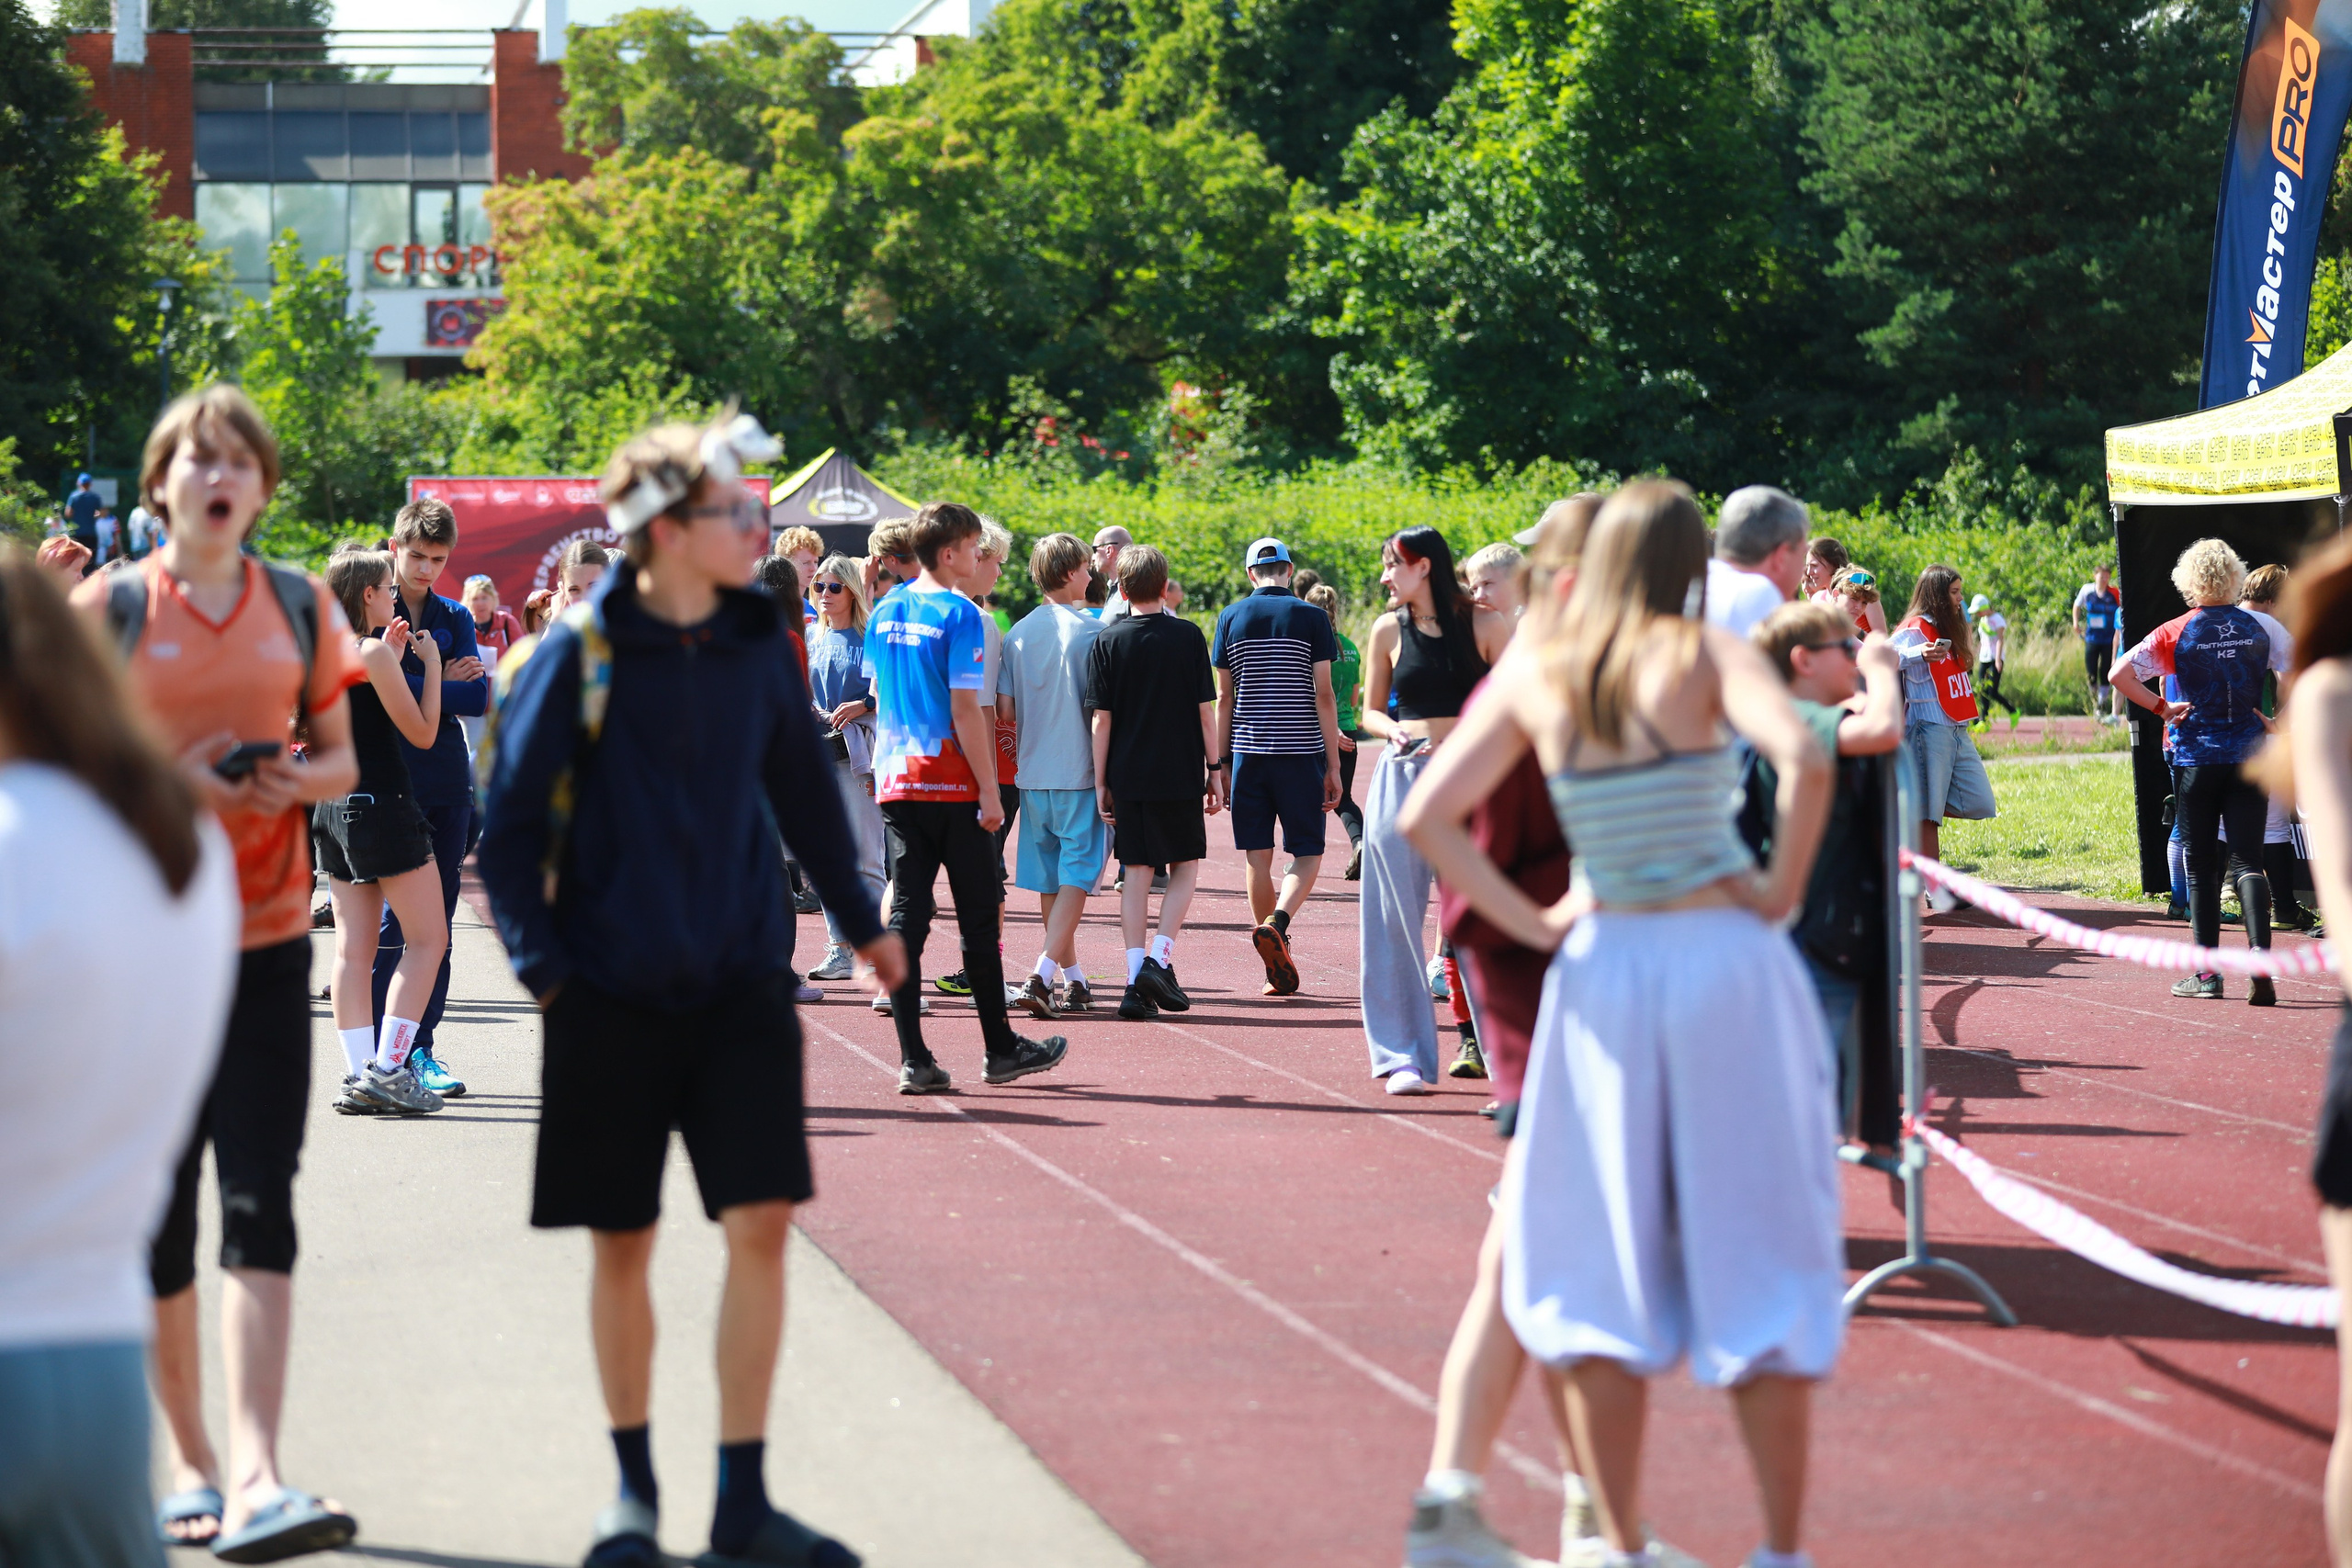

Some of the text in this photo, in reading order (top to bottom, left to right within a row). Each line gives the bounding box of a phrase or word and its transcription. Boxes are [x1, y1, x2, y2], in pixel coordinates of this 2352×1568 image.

[2278, 37, 2312, 164] PRO
[374, 243, 513, 275] СПОР
[533, 526, 618, 592] ЕРВЕНСТВО
[2197, 639, 2253, 649] ЛЫТКАРИНО
